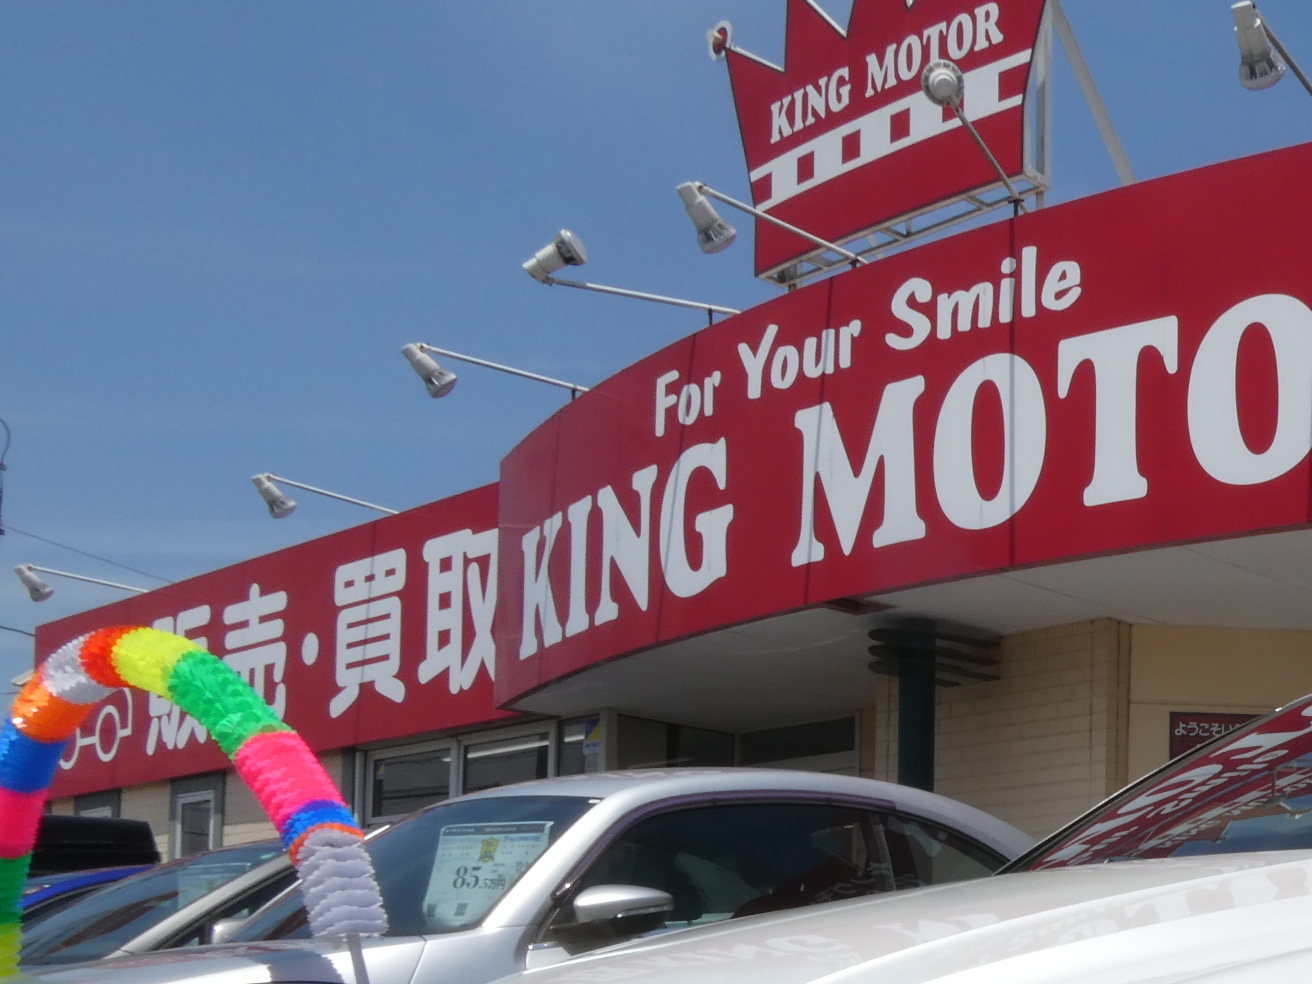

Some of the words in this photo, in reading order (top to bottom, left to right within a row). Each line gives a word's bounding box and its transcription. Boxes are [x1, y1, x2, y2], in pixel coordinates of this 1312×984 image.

[770, 66, 851, 144] KING
[865, 2, 1003, 98] MOTOR
[655, 369, 721, 437] For
[738, 323, 862, 400] Your
[886, 246, 1081, 350] Smile
[518, 437, 734, 660] KING
